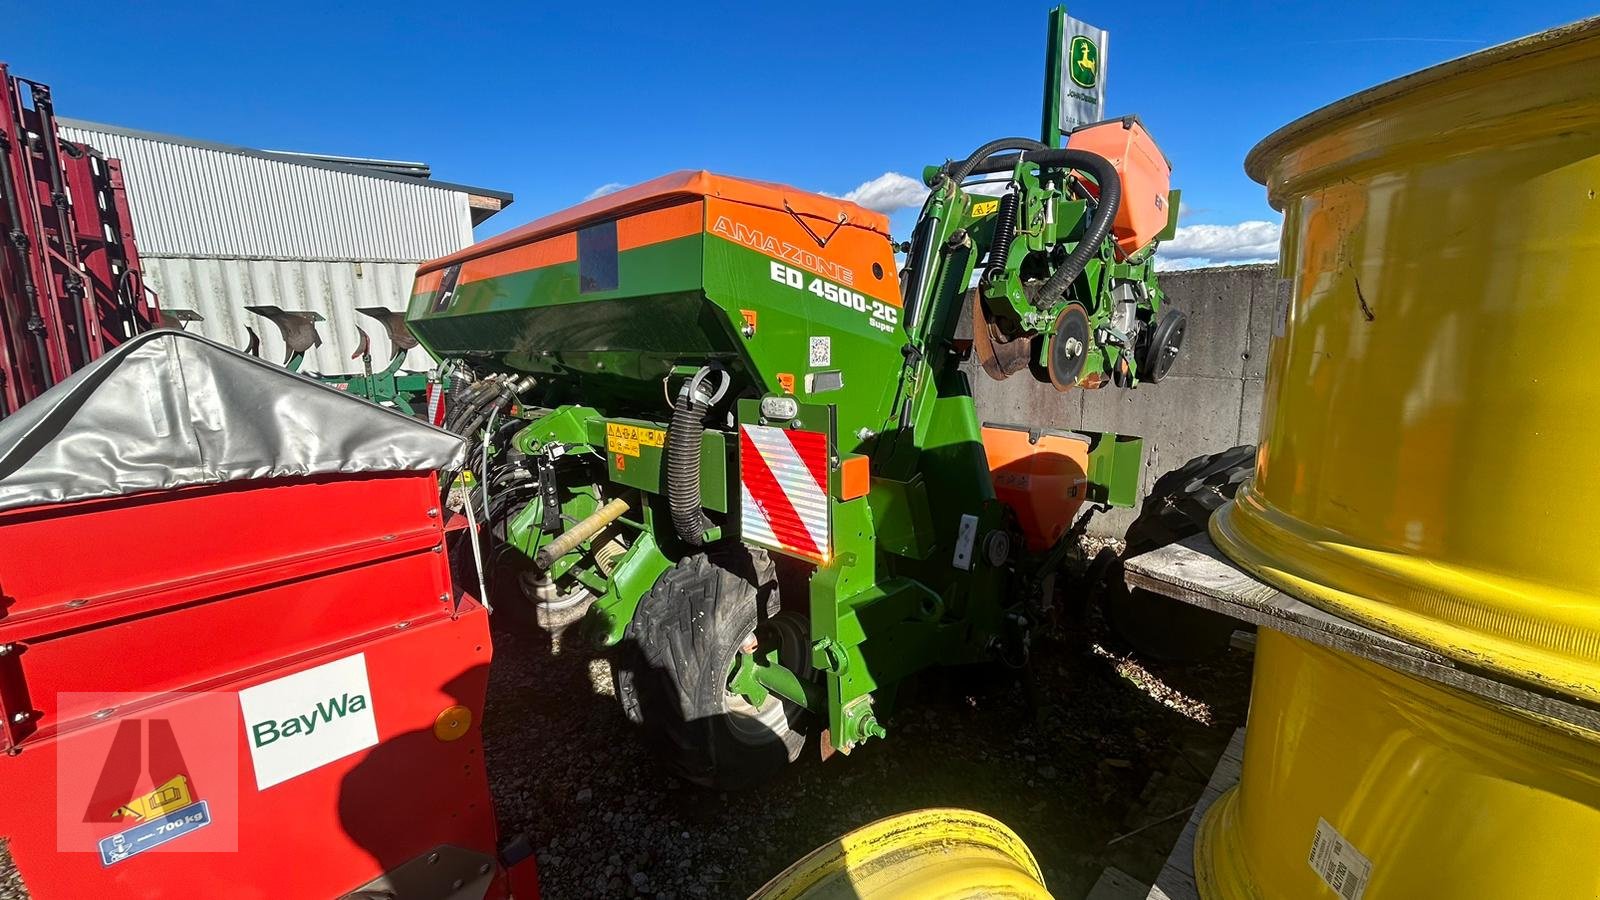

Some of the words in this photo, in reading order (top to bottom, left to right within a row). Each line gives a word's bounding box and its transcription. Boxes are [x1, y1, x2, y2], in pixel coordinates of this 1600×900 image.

[713, 215, 854, 286] AMAZONE
[770, 260, 804, 290] ED
[808, 278, 898, 325] 4500-2C
[869, 317, 895, 334] Super
[252, 693, 367, 748] BayWa
[156, 818, 184, 836] 700
[184, 811, 204, 825] kg
